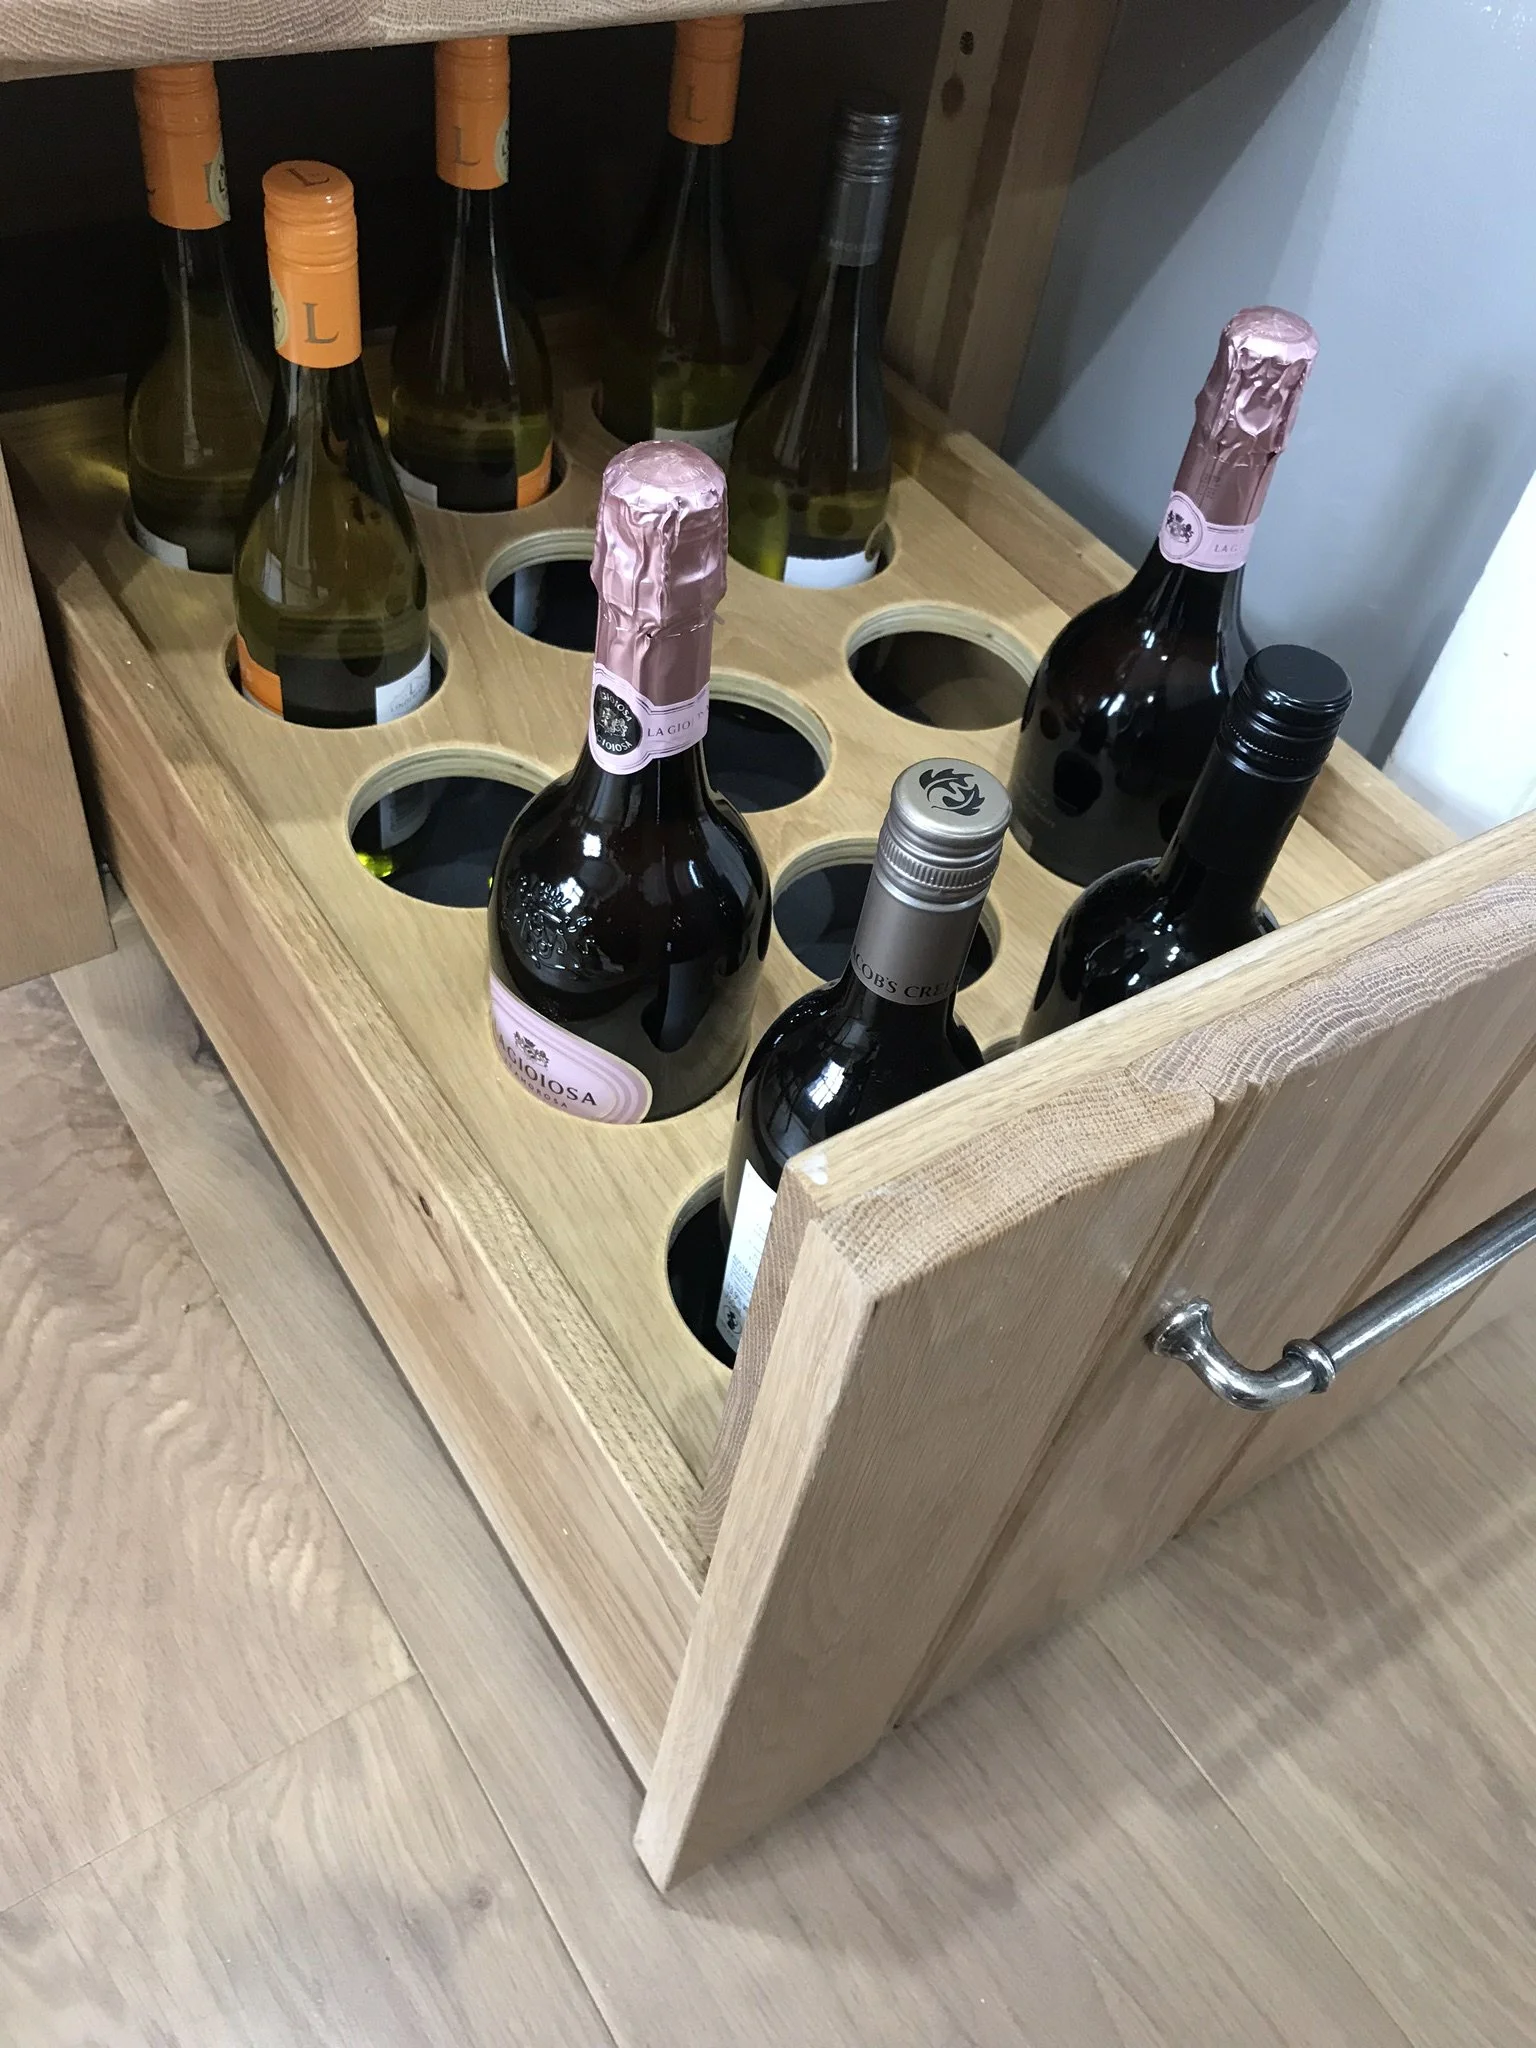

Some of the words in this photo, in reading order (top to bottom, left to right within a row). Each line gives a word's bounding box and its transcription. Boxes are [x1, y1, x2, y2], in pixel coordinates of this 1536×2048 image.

[686, 86, 708, 124] L
[453, 126, 481, 167] L
[286, 167, 330, 188] L
[302, 302, 340, 344] L
[600, 691, 633, 722] GIOIOSA
[647, 727, 664, 738] LA
[507, 1046, 597, 1106] GIOIOSA
